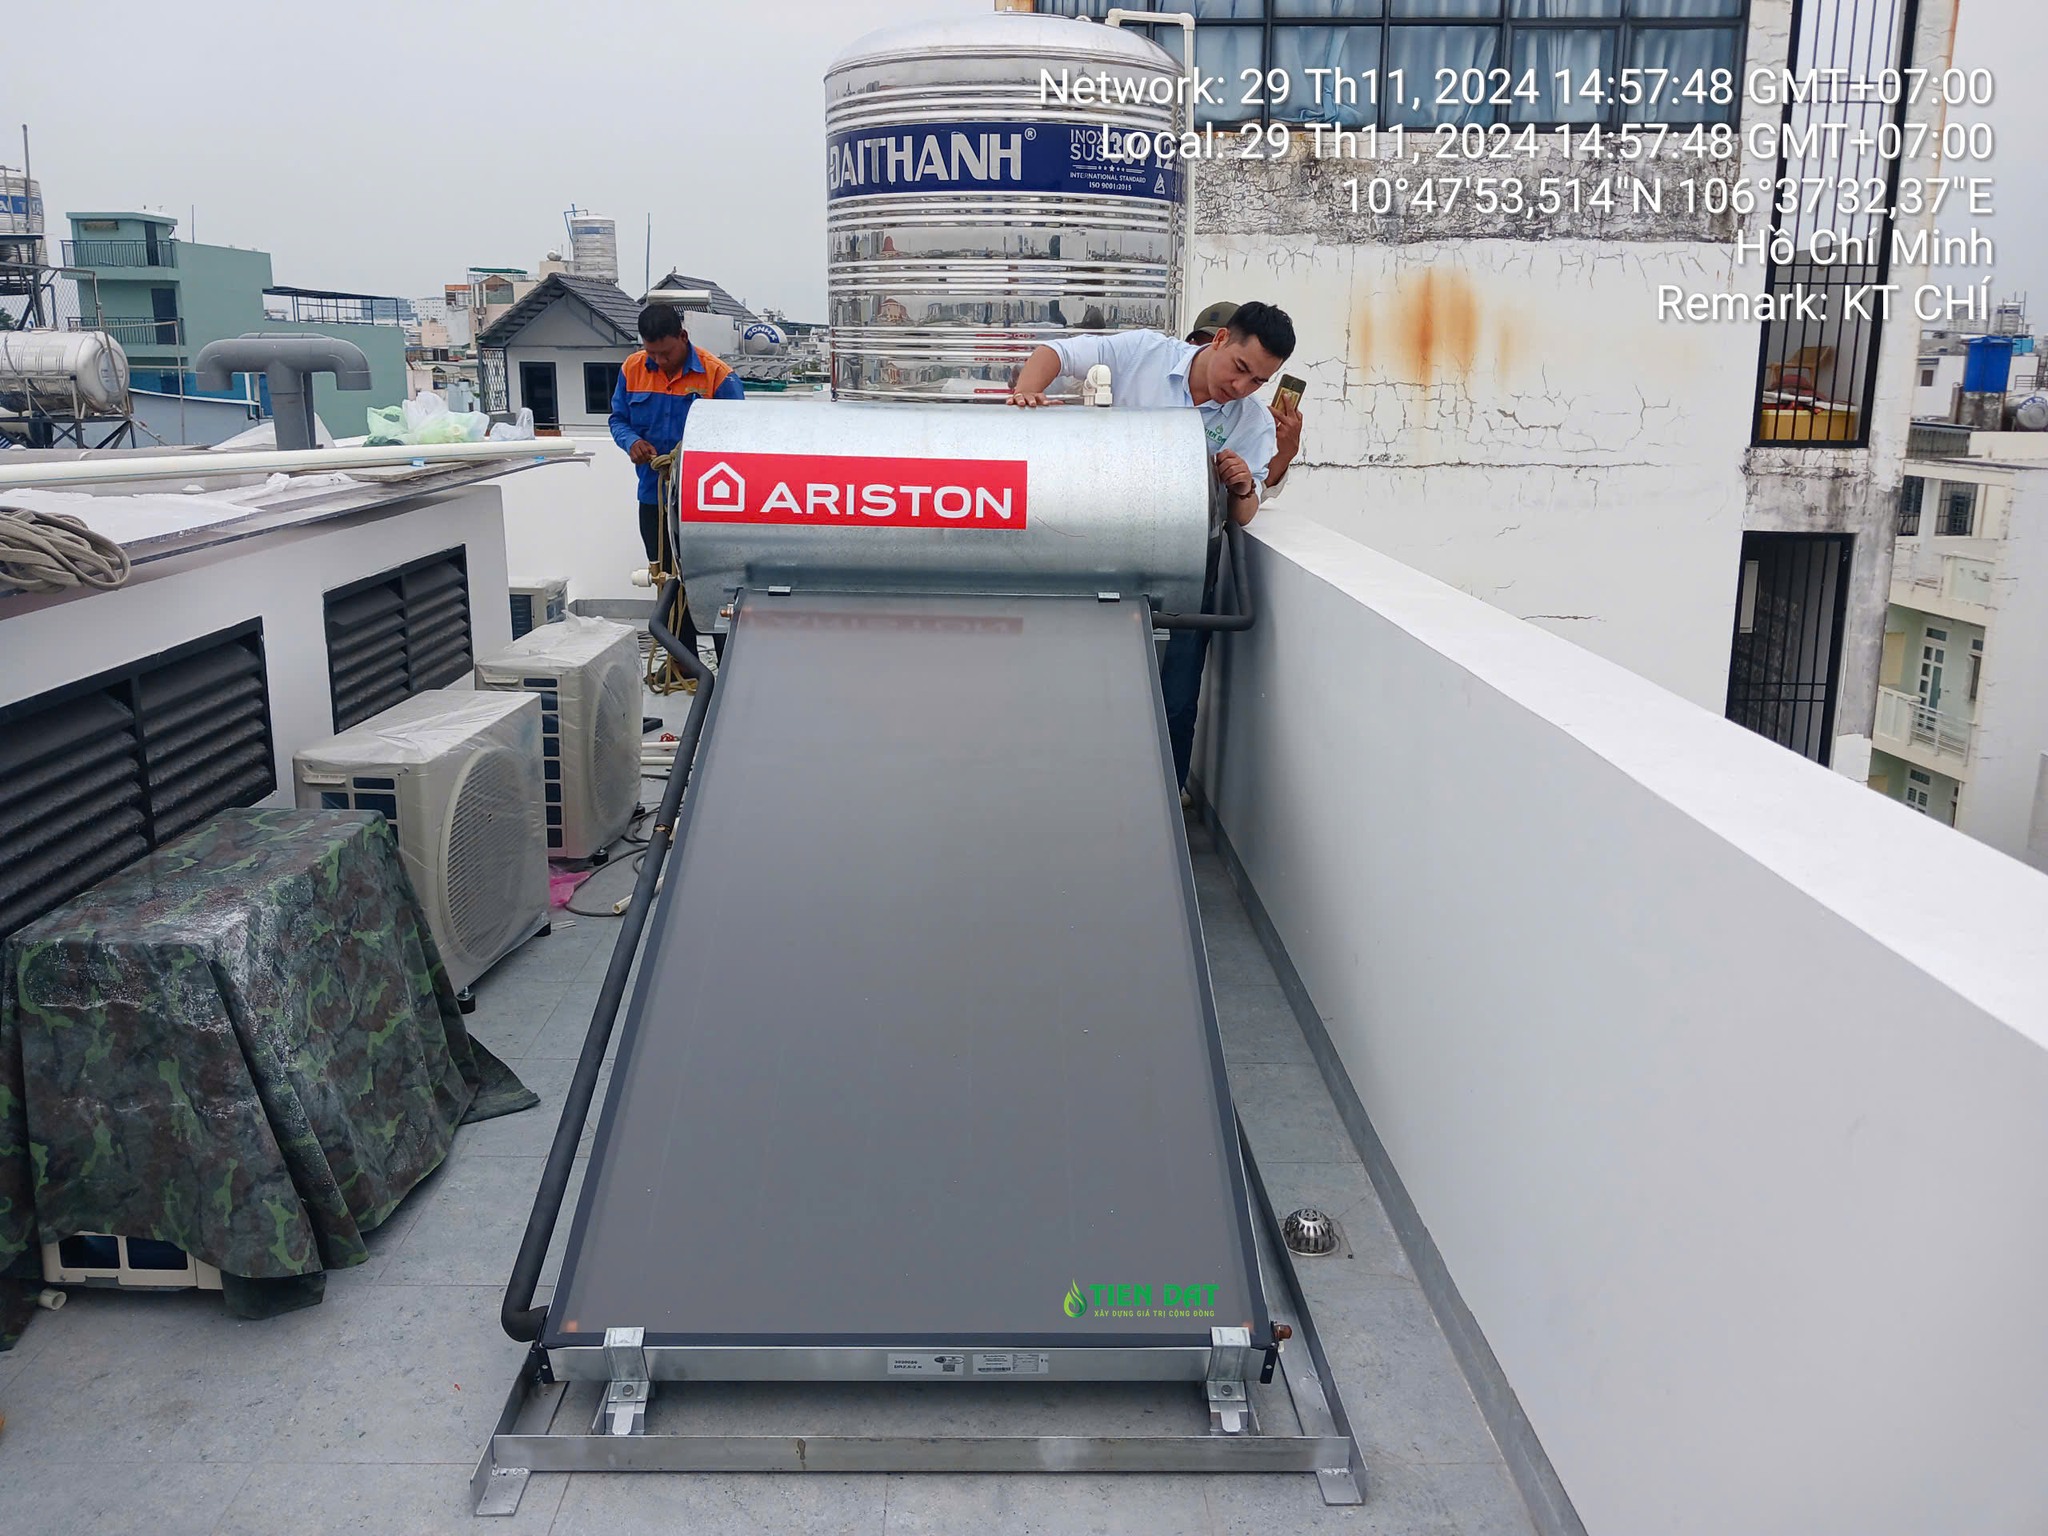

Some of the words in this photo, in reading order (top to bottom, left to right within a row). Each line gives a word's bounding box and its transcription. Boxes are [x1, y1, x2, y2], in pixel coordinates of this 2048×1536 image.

[1070, 129, 1104, 145] INOX
[1070, 172, 1118, 181] INTERNATIONAL
[1119, 174, 1147, 184] STANDARD
[1101, 182, 1132, 191] 9001:2015
[760, 481, 1012, 519] ARISTON
